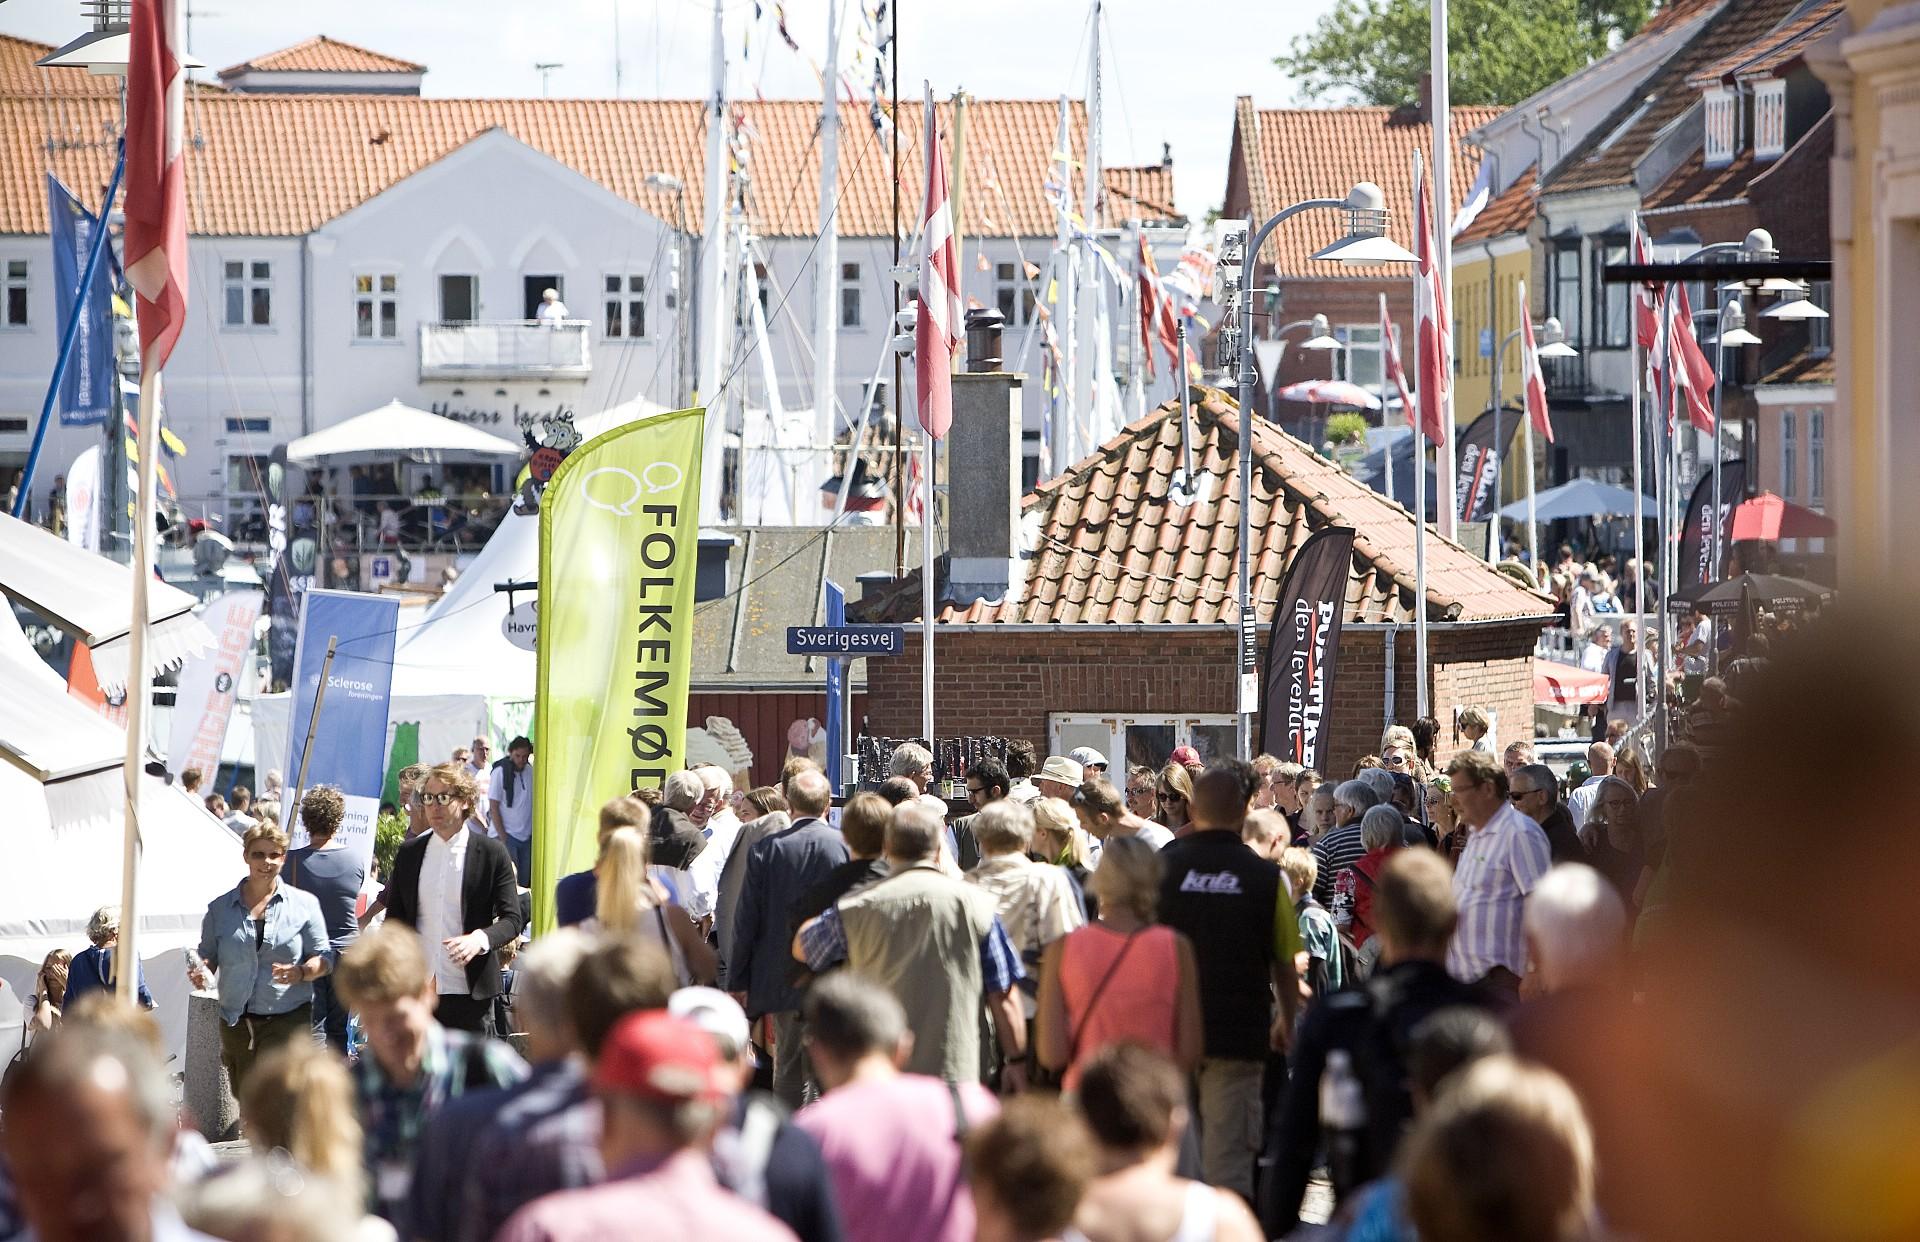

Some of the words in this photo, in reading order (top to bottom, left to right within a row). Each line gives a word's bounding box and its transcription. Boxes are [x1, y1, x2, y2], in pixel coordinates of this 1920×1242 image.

[1295, 598, 1314, 641] den
[796, 629, 894, 651] Sverigesvej
[327, 675, 373, 691] Sclerose
[348, 690, 383, 702] foreningen
